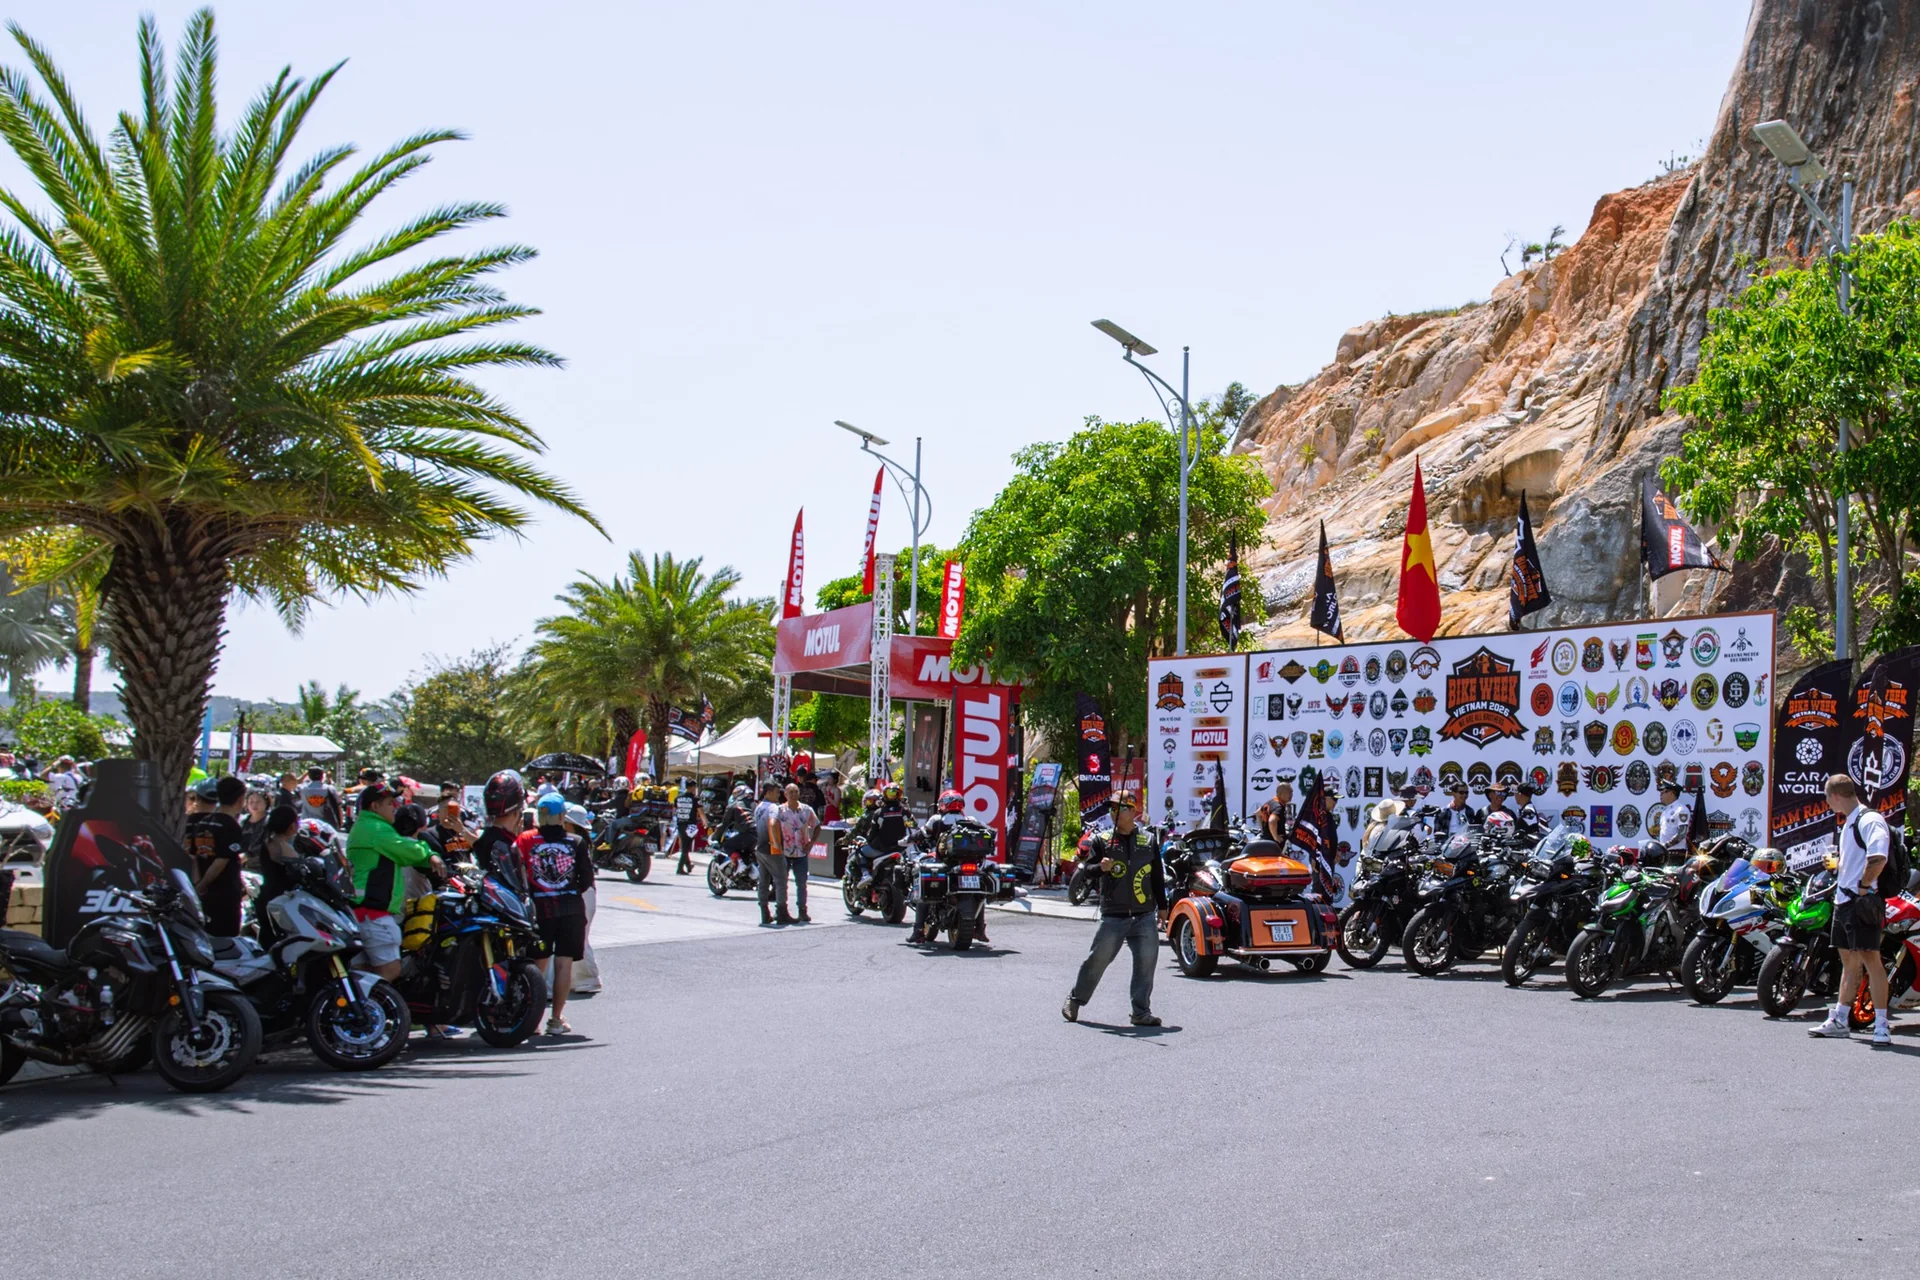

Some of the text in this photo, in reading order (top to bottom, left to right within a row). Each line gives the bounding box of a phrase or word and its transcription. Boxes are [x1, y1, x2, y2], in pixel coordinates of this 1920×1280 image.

[1671, 528, 1684, 565] MOTUL
[790, 530, 804, 607] MOTUL
[944, 561, 963, 638] MOTUL
[804, 624, 841, 657] MOTUL
[1448, 675, 1518, 709] BIKE WEEK
[1308, 701, 1320, 709] 1976
[1453, 701, 1510, 718] VIETNAM 2026
[1788, 700, 1837, 715] BIKE WEEK
[1792, 710, 1832, 719] VIETNAM 2026
[1193, 731, 1226, 744] MOTUL
[1778, 784, 1826, 794] WORL
[1595, 815, 1608, 824] MC
[1772, 810, 1800, 829] CAM
[1772, 822, 1799, 836] LONG
[1806, 810, 1832, 823] BEAC
[1793, 844, 1807, 853] WE
[1806, 848, 1819, 857] ALL
[1792, 855, 1823, 871] BROTHE
[1134, 868, 1146, 895] DALAT
